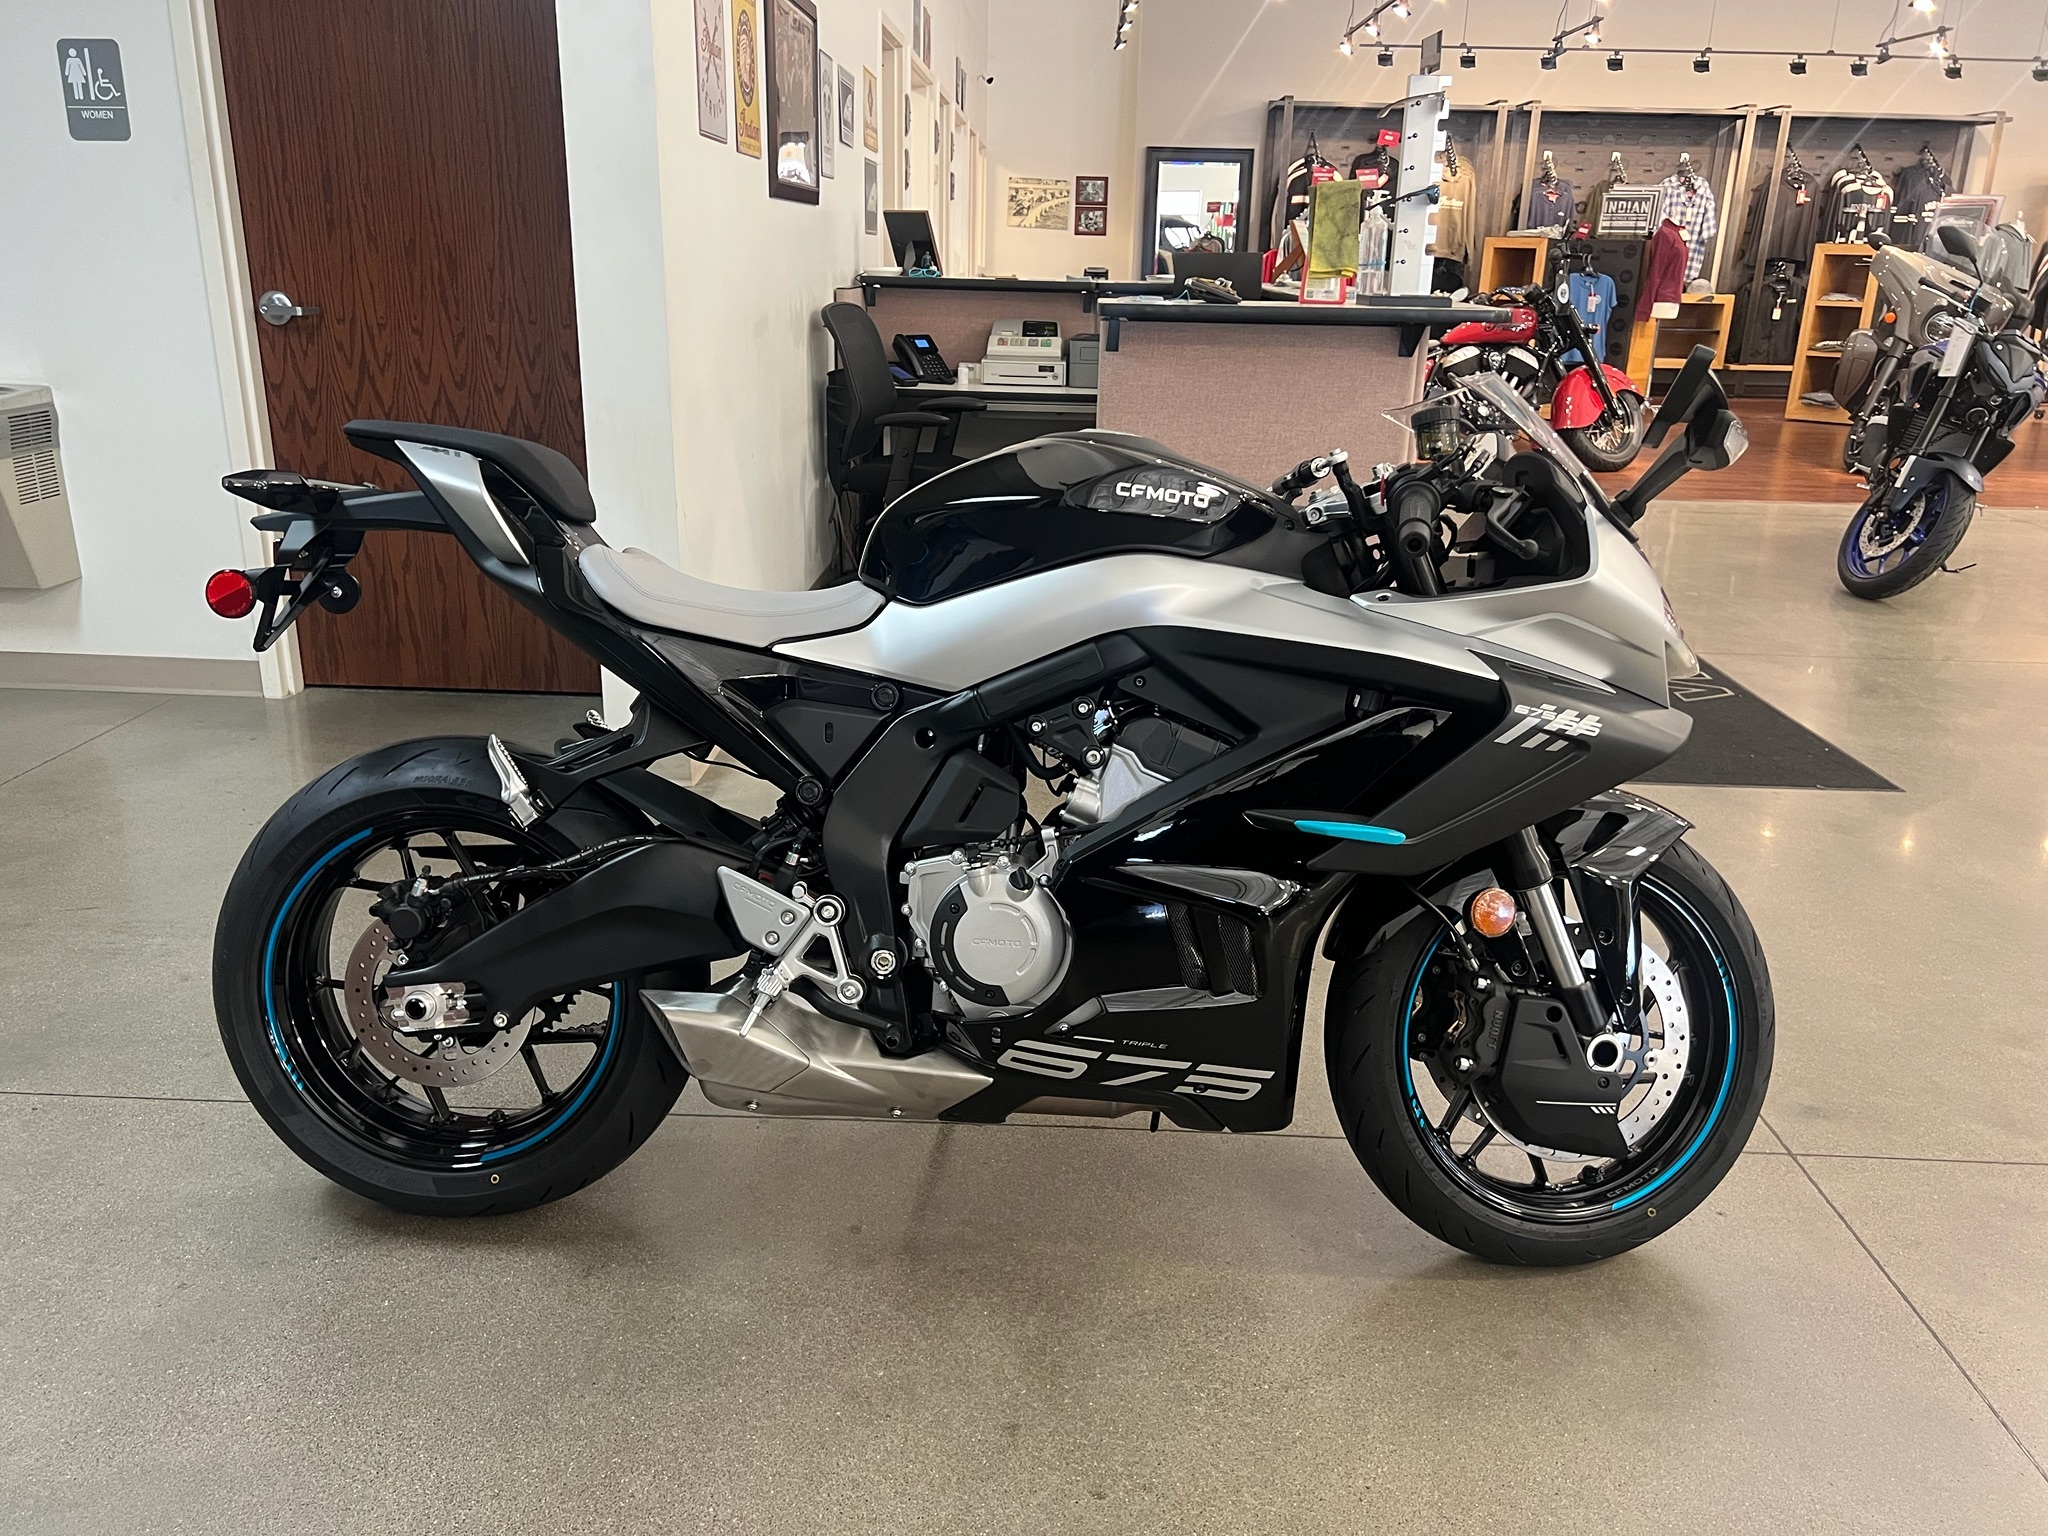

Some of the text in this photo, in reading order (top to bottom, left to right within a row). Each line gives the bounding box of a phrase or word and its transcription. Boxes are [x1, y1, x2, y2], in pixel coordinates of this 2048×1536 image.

[80, 110, 114, 119] WOMEN
[1603, 200, 1650, 214] INDIAN
[1115, 481, 1211, 509] CFMOTO
[732, 881, 776, 909] CFMOTO
[972, 937, 1022, 949] CFMOTO
[1121, 1039, 1169, 1050] TRIPLE
[997, 1039, 1276, 1101] 675
[1606, 1166, 1660, 1198] CFMOTO
